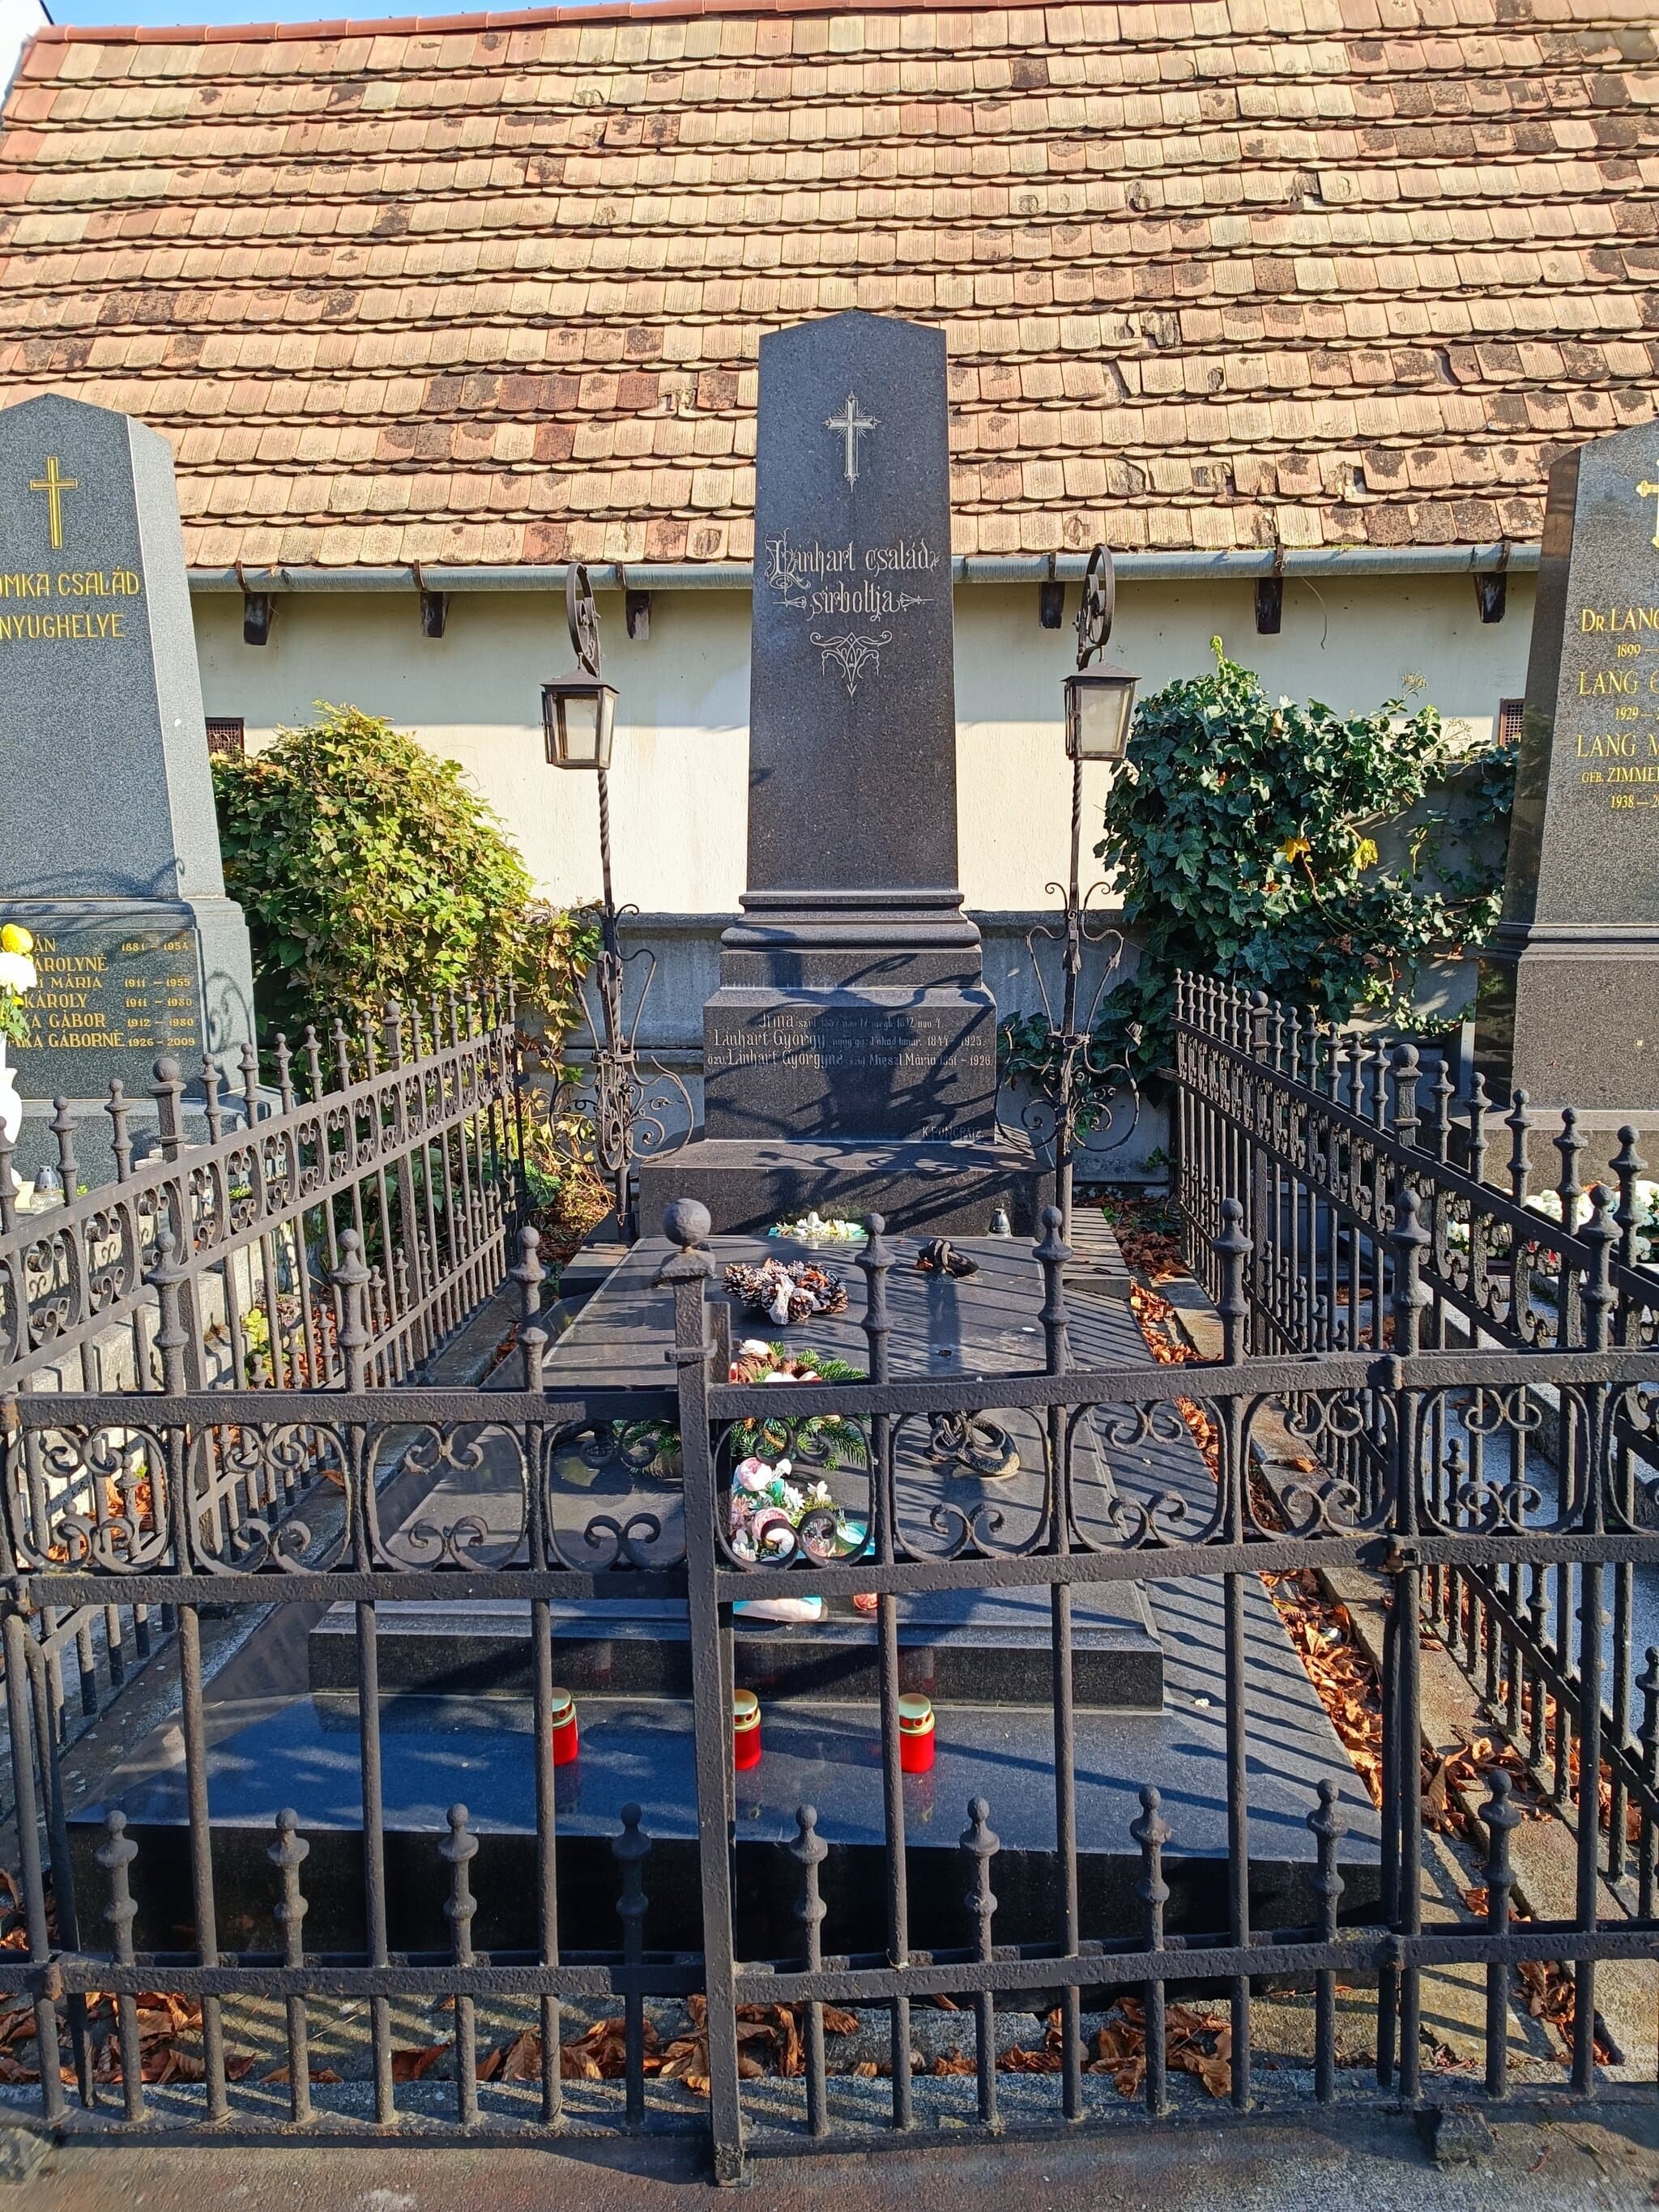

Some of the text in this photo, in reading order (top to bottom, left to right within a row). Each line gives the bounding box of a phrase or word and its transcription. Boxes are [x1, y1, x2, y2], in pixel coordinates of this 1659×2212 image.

[58, 565, 140, 597] CSALÁD
[0, 612, 126, 639] NYUGHELYE
[1617, 643, 1641, 658] 1899
[1578, 671, 1640, 696] LANG
[1614, 706, 1639, 721] 1929
[1576, 733, 1636, 757] LANG
[1606, 766, 1659, 783] ZIMME
[1610, 795, 1635, 808] 1938
[32, 953, 109, 973] ÁROLYNÉ
[50, 973, 103, 989] MÁRIA
[166, 977, 192, 988] 1955
[24, 991, 87, 1010] KÁROLY
[167, 997, 193, 1008] 1980
[49, 1009, 106, 1029] GÁBOR
[168, 1017, 194, 1028] 1980
[49, 1028, 125, 1048] GÁBORNÉ
[128, 1038, 154, 1047] 1926
[167, 1038, 195, 1047] 2009
